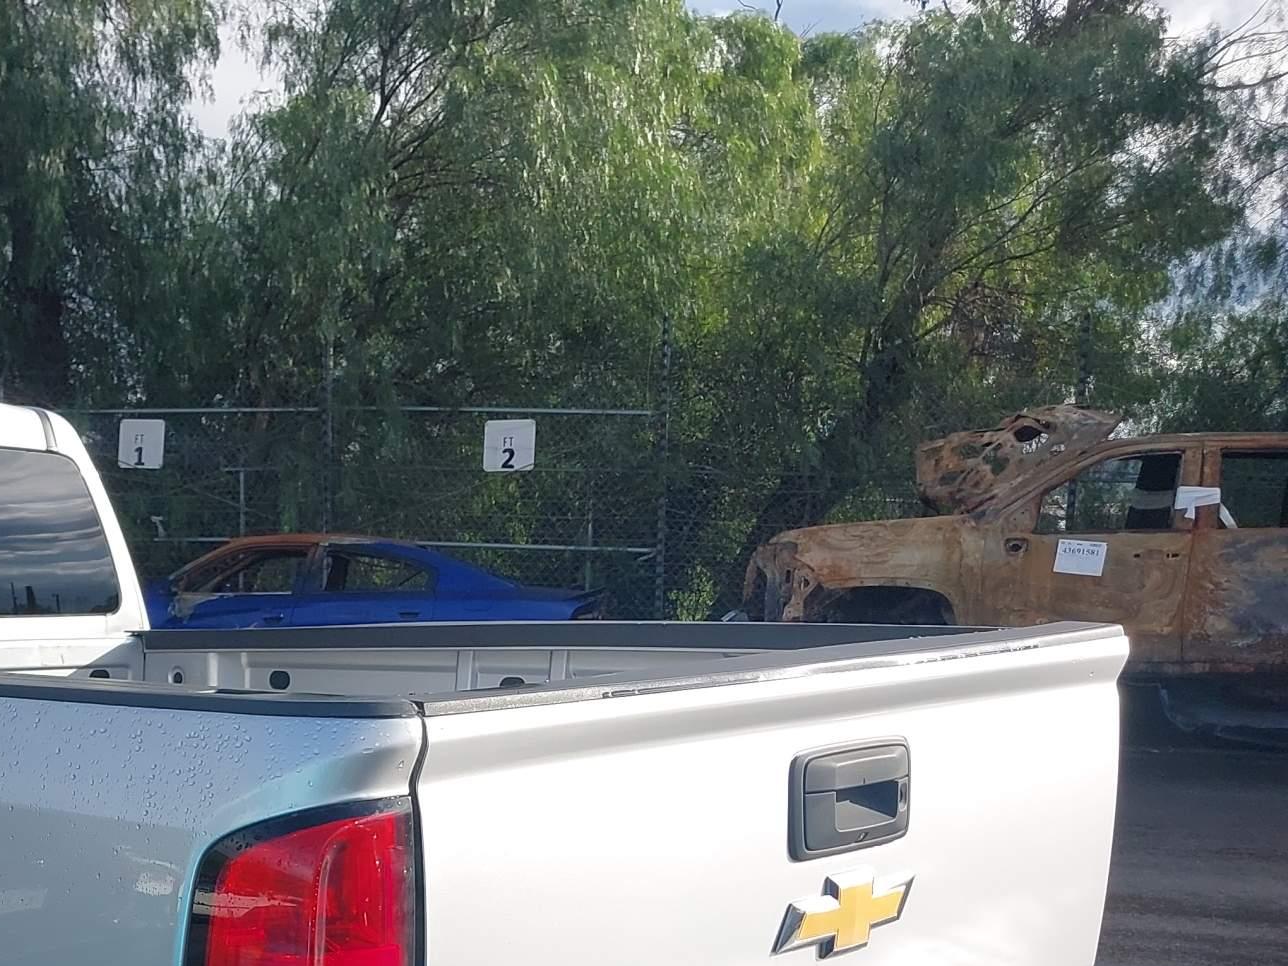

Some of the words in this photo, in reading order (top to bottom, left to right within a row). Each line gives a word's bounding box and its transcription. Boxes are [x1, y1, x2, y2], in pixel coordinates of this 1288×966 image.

[503, 436, 514, 448] FT
[134, 446, 145, 466] 1
[501, 448, 515, 469] 2
